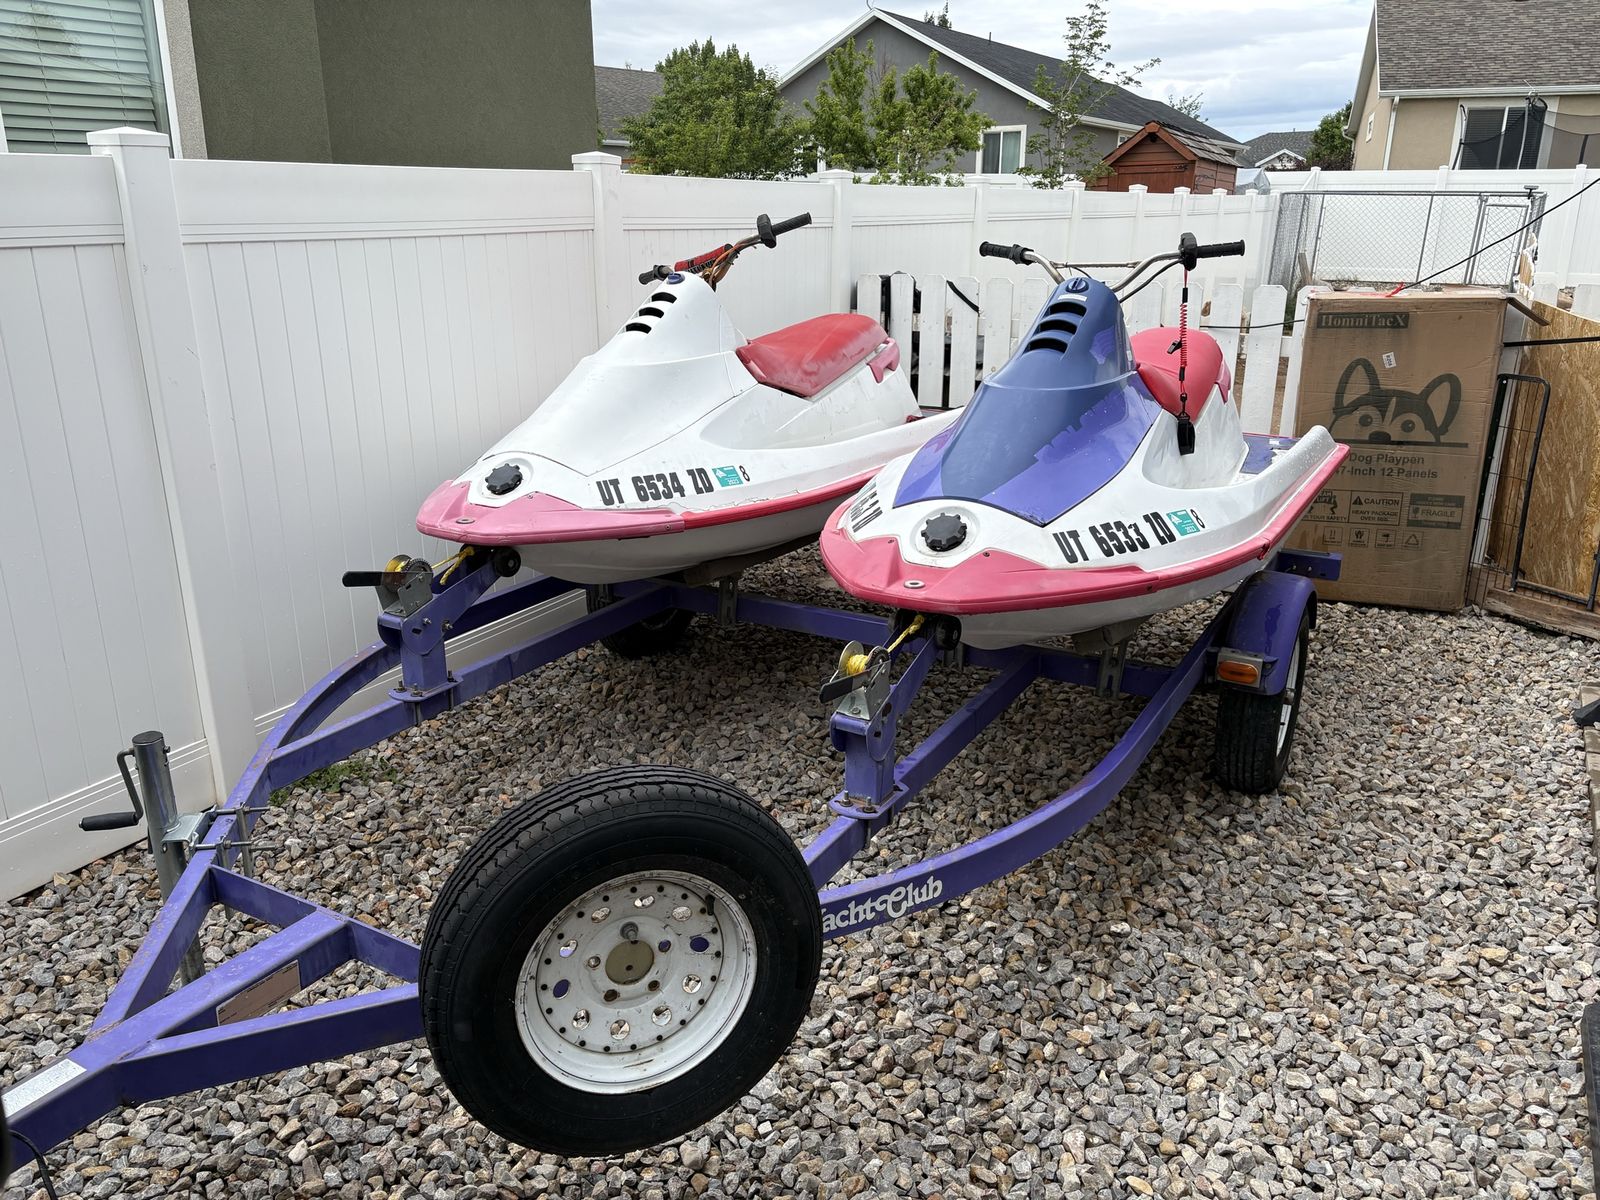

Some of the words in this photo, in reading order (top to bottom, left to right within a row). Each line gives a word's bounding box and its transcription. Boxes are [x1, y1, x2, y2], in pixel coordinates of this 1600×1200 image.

[1349, 453, 1373, 465] Dog
[1376, 453, 1424, 465] Playpen
[739, 465, 751, 482] 8
[1380, 467, 1393, 477] 12
[1397, 468, 1438, 479] Panels
[596, 478, 625, 506] UT
[631, 472, 686, 502] 6534
[1364, 498, 1400, 507] CAUTION
[1190, 508, 1206, 529] 8
[1420, 509, 1456, 518] FRAGILE
[1052, 530, 1090, 564] UT
[1088, 520, 1151, 558] 6533
[820, 900, 876, 934] acht
